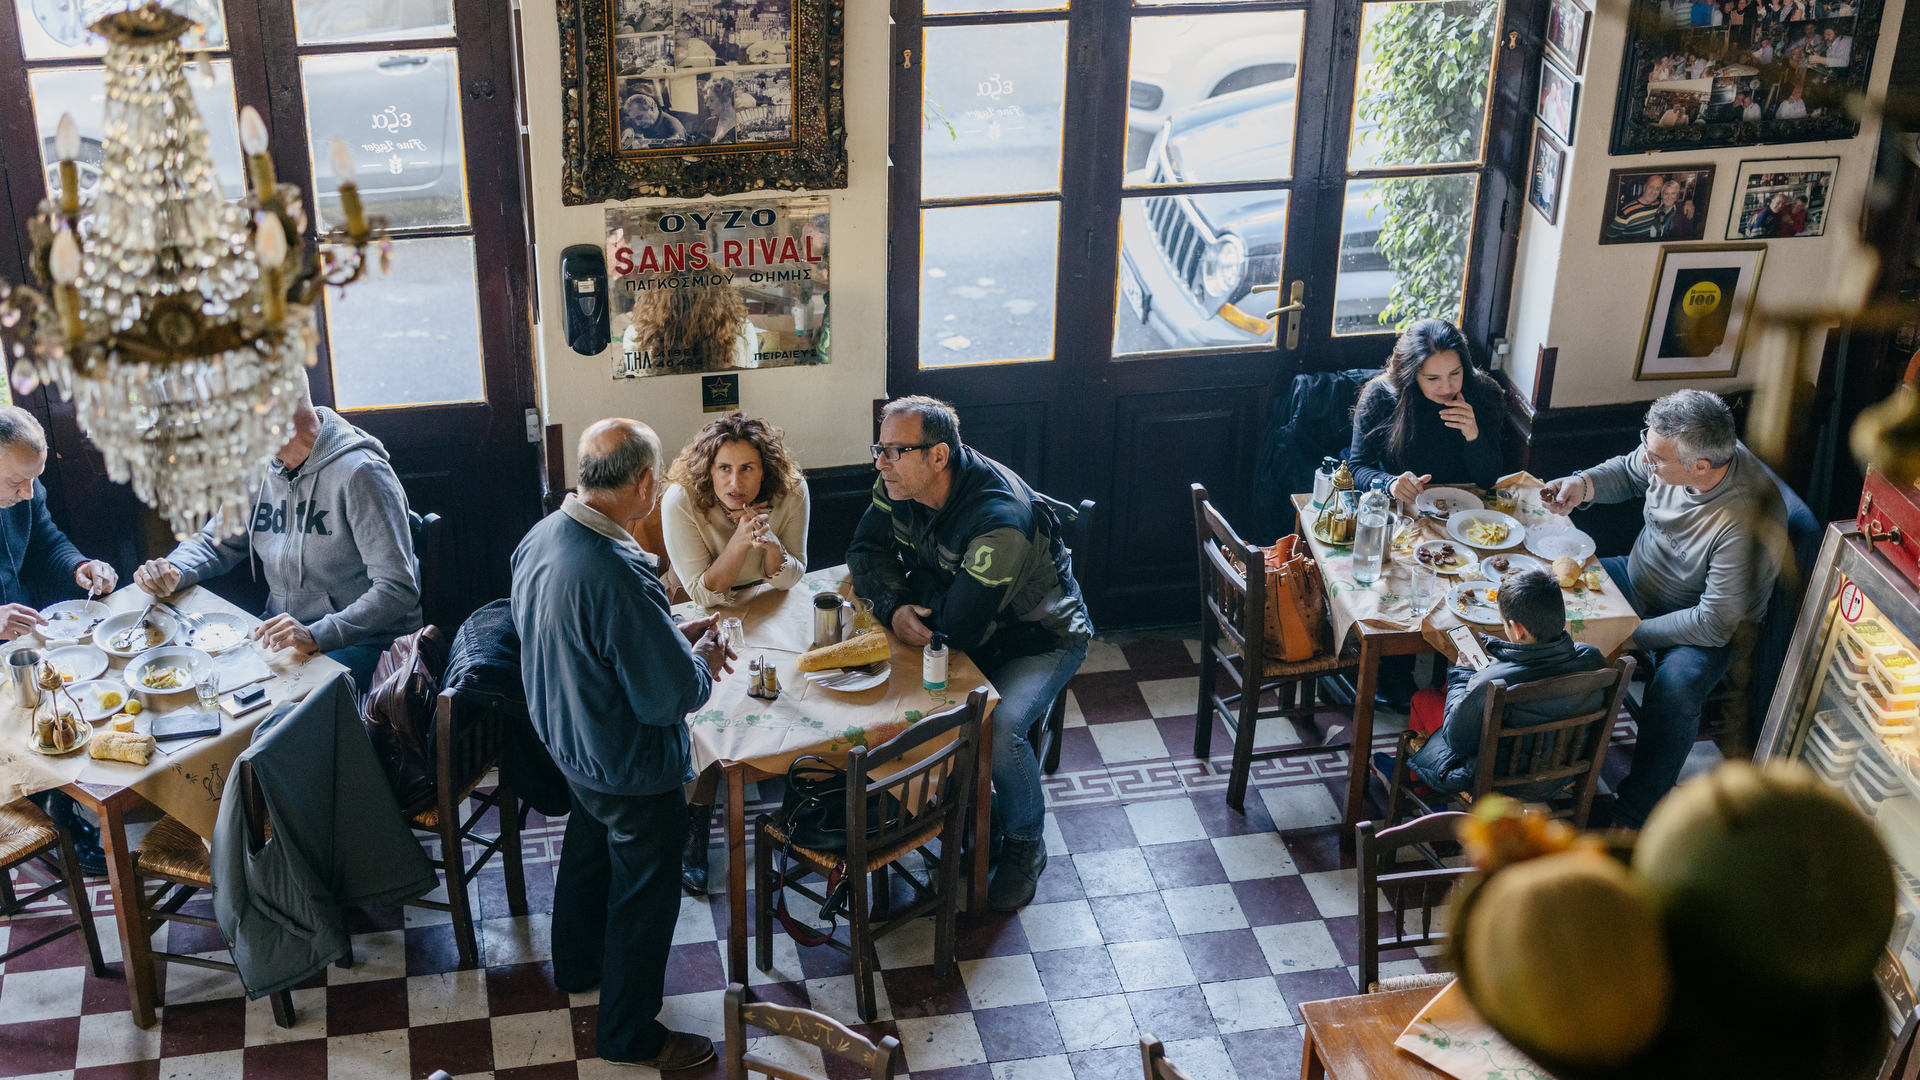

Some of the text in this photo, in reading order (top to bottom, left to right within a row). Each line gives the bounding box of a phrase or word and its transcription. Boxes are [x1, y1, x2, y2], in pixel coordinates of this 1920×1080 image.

[658, 208, 777, 233] ΟΥΖΟ
[614, 235, 822, 275] SANS RIVAL
[625, 268, 812, 292] ΠΑΓΚΟΣΜΙΟΥ ΦΗΜΗΣ
[1688, 294, 1716, 306] 100
[754, 348, 817, 360] ΠΕΙΡΑΙΕΥΣ
